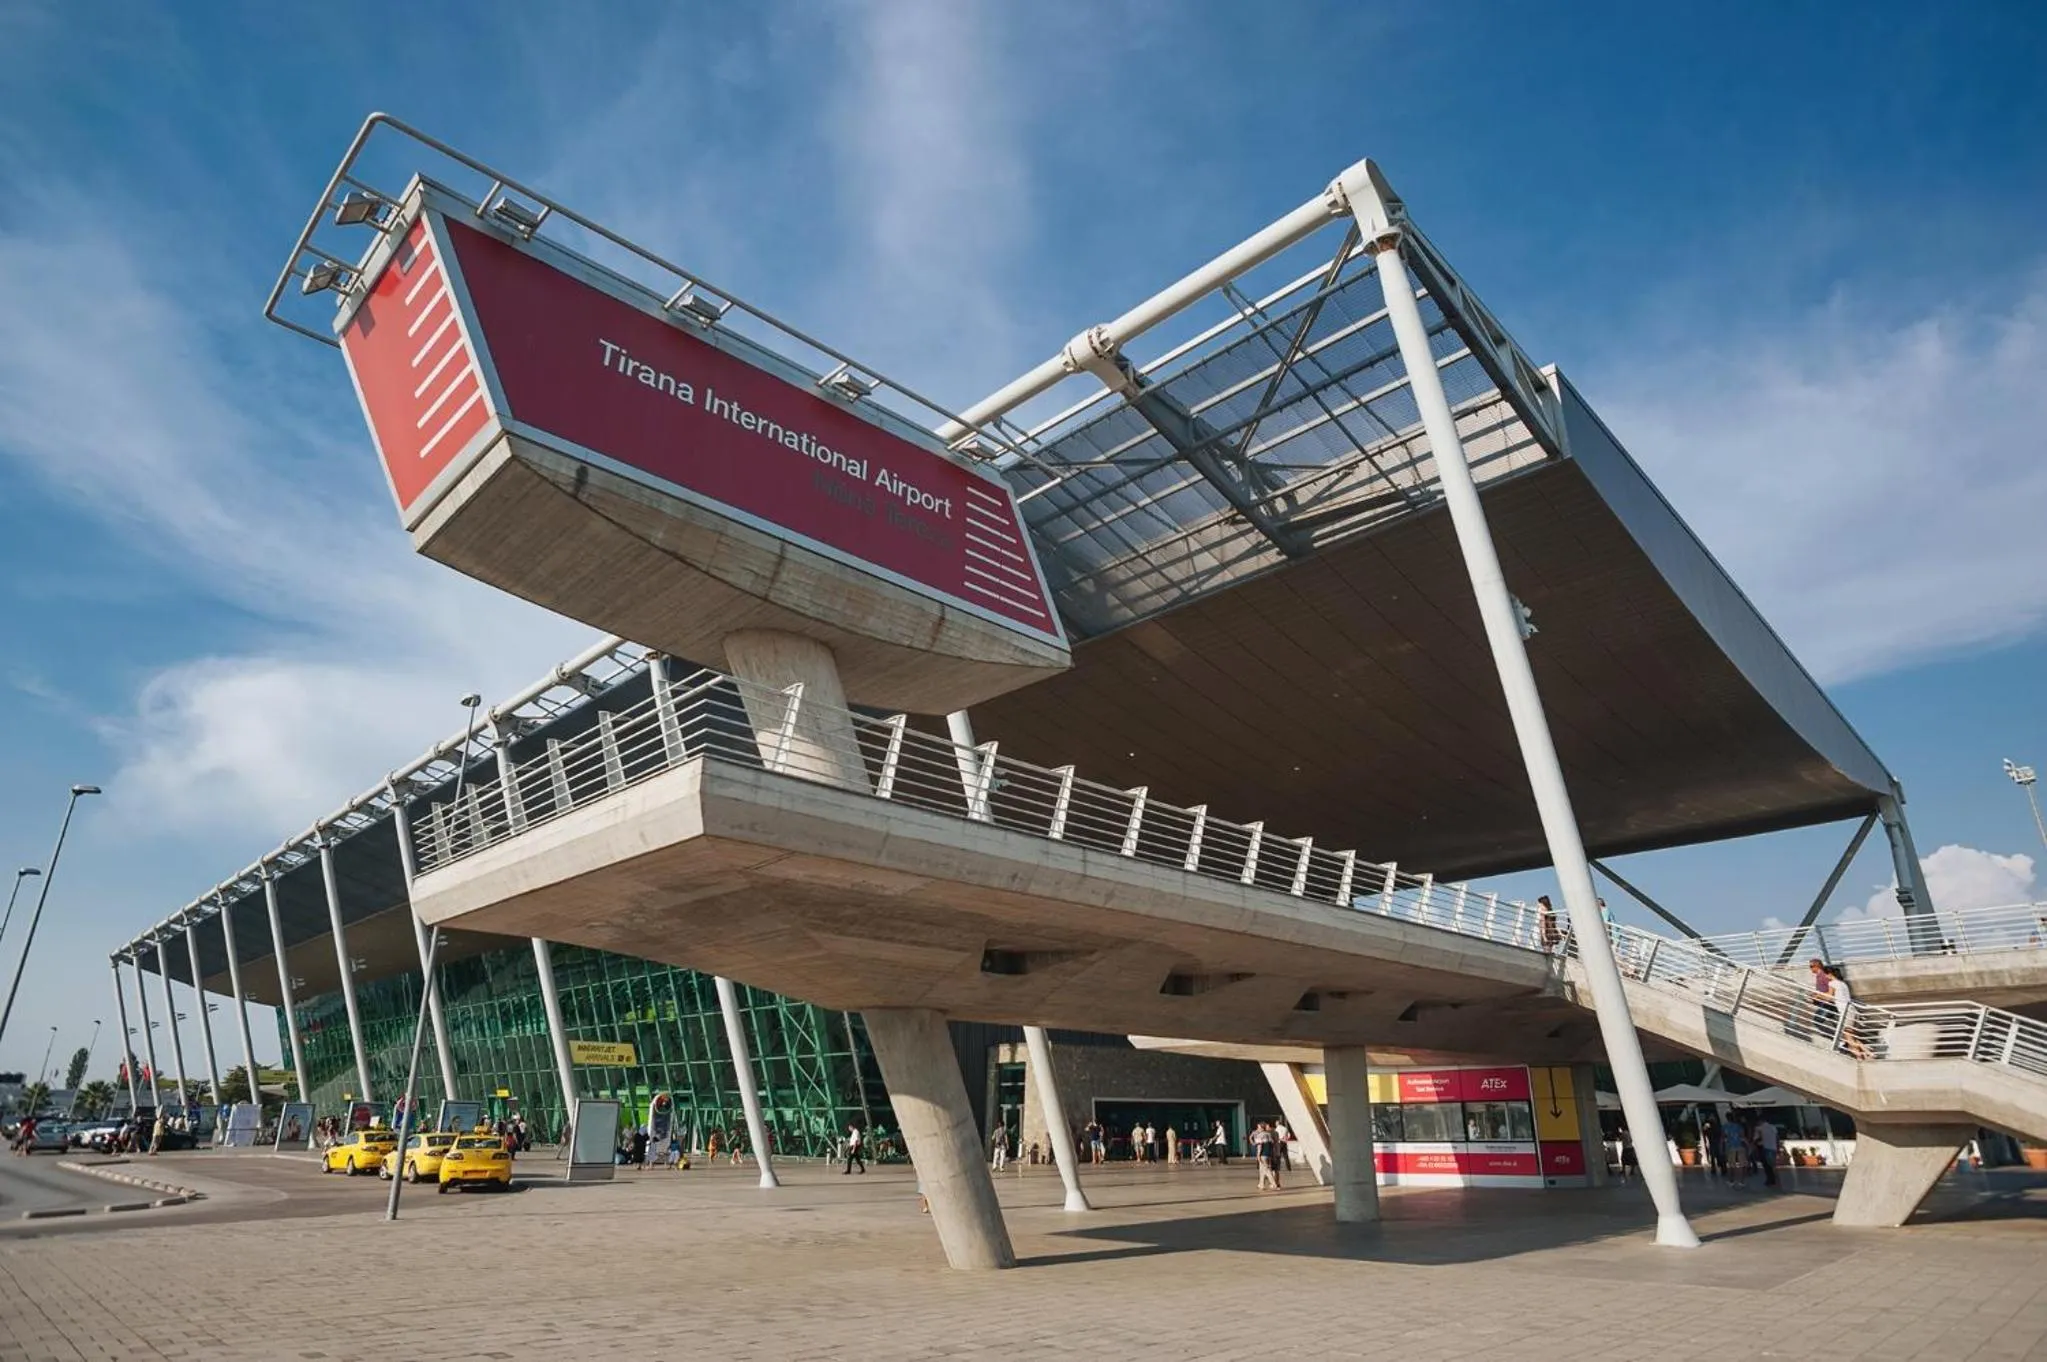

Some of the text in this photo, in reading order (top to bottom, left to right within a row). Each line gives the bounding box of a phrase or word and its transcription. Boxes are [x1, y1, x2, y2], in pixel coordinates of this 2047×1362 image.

[599, 337, 695, 405] Tirana
[704, 387, 868, 482] International
[874, 467, 953, 520] Airport
